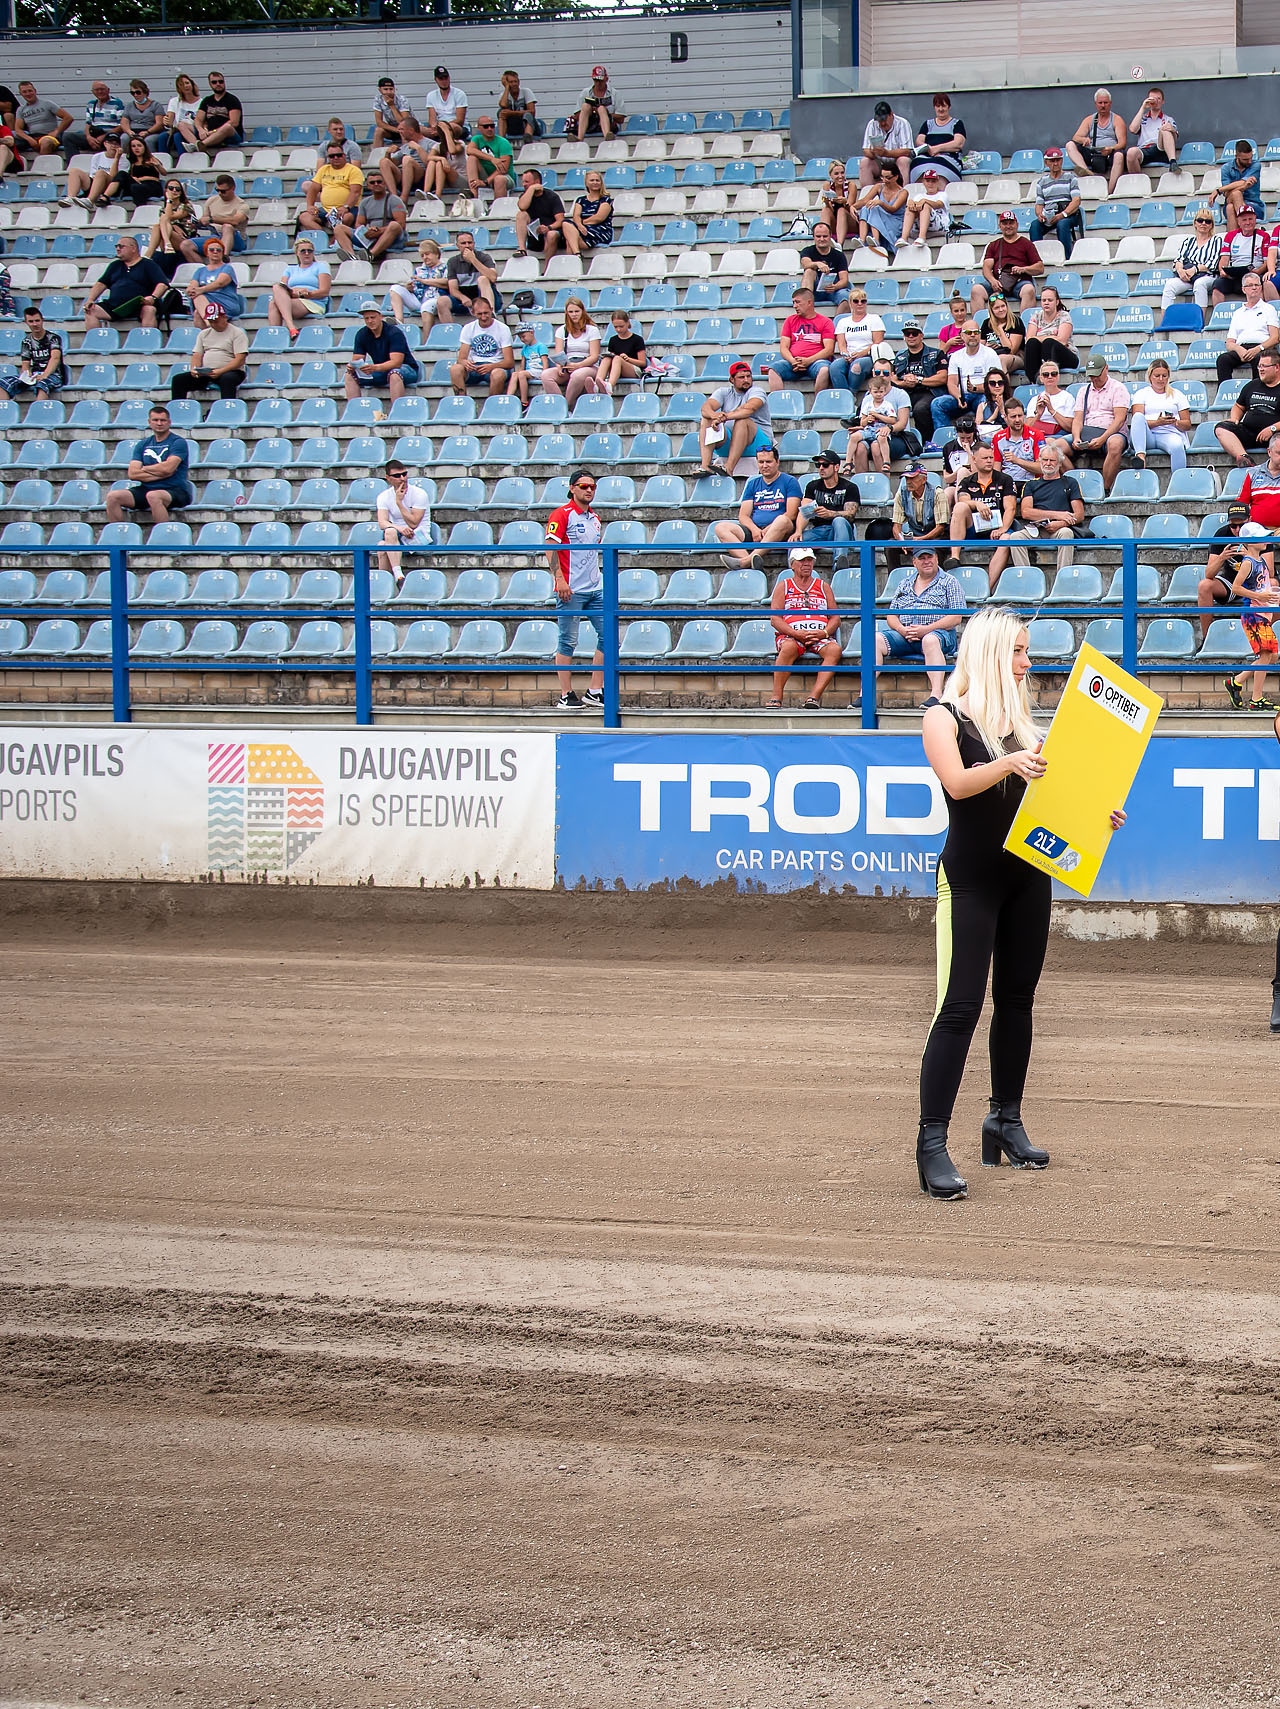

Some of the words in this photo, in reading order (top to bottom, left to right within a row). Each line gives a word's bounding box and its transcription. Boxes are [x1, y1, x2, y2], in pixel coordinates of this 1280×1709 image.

[670, 32, 688, 63] D
[1105, 687, 1140, 719] OPTIBET
[339, 747, 517, 781] DAUGAVPILS
[338, 794, 360, 826] IS
[371, 795, 503, 829] SPEEDWAY
[613, 764, 949, 835] TROD
[1034, 832, 1056, 855] 2LŻ
[716, 849, 763, 869] CAR
[771, 850, 844, 871] PARTS
